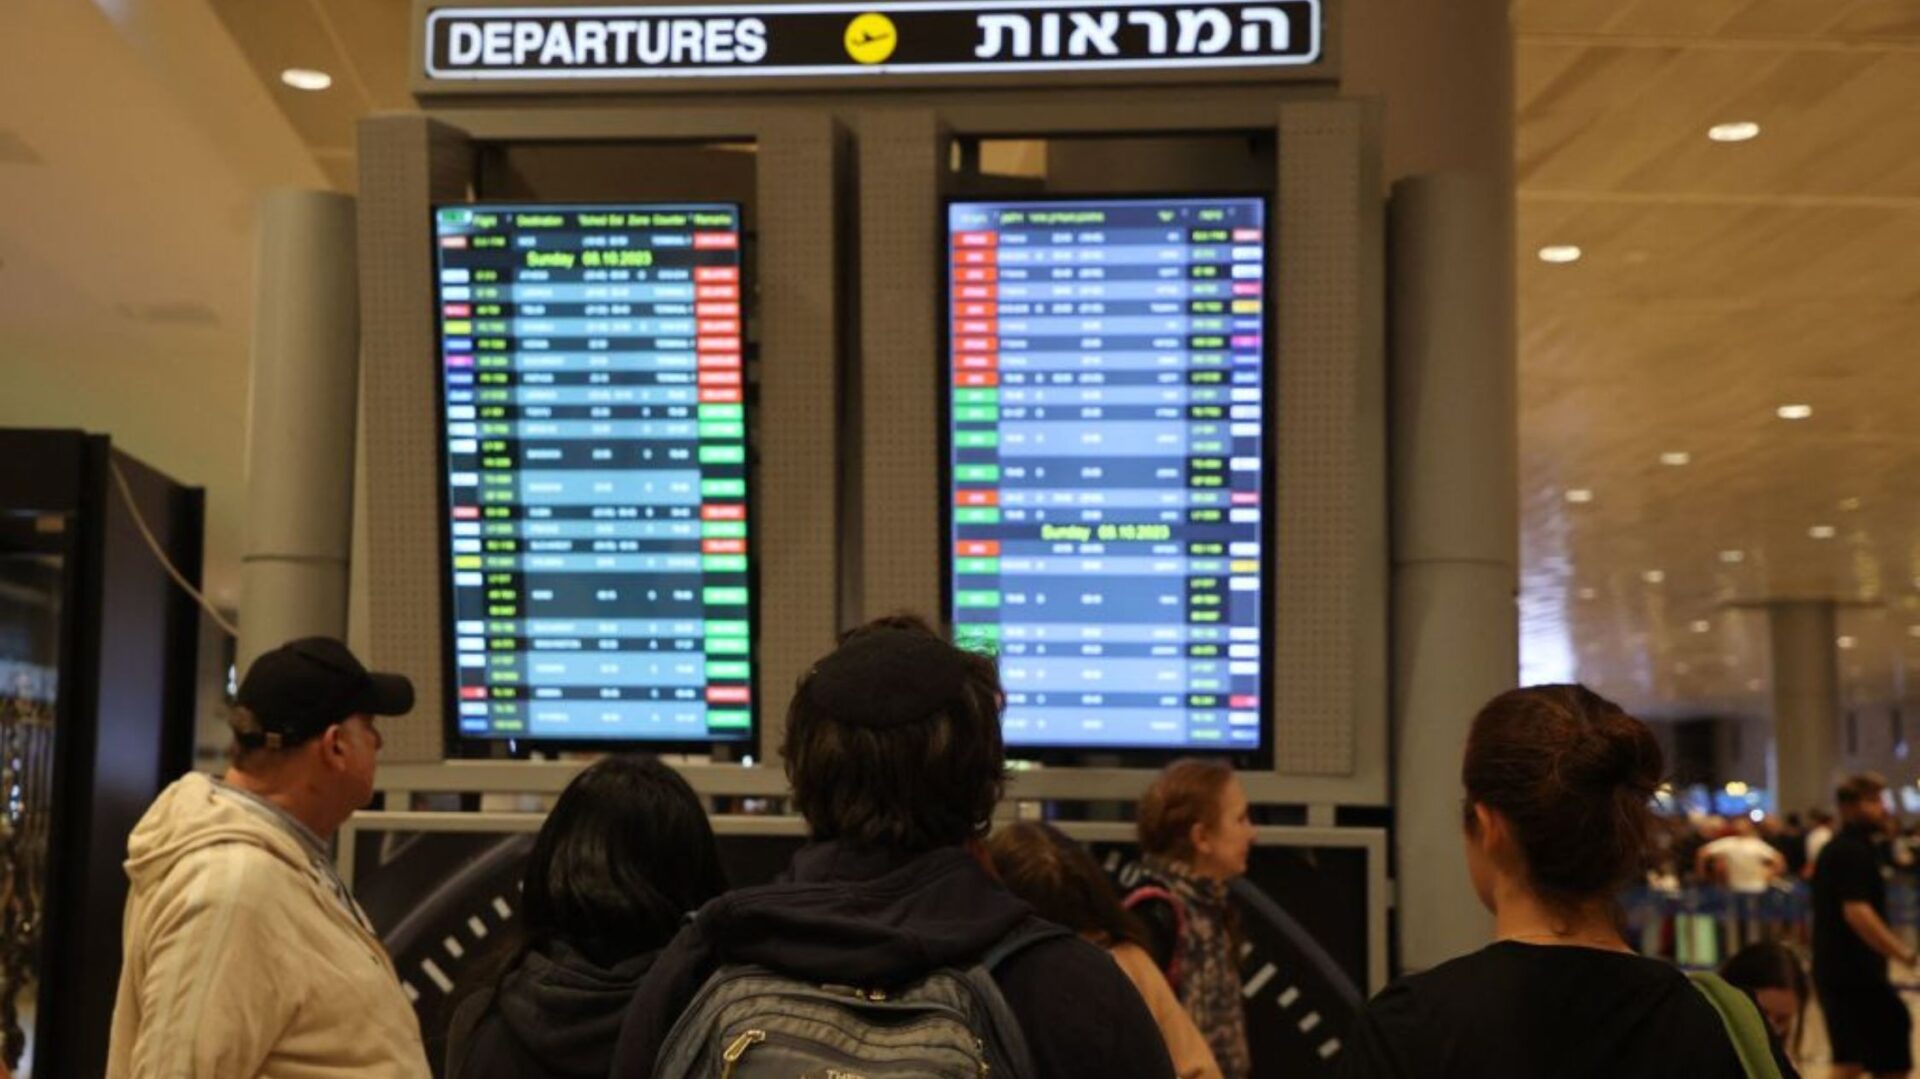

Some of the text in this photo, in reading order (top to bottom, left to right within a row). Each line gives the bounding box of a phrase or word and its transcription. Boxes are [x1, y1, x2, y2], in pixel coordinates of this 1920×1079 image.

[448, 18, 767, 65] DEPARTURES
[974, 7, 1290, 58] המראות
[527, 251, 574, 268] Sunday
[1041, 524, 1091, 543] Sunday
